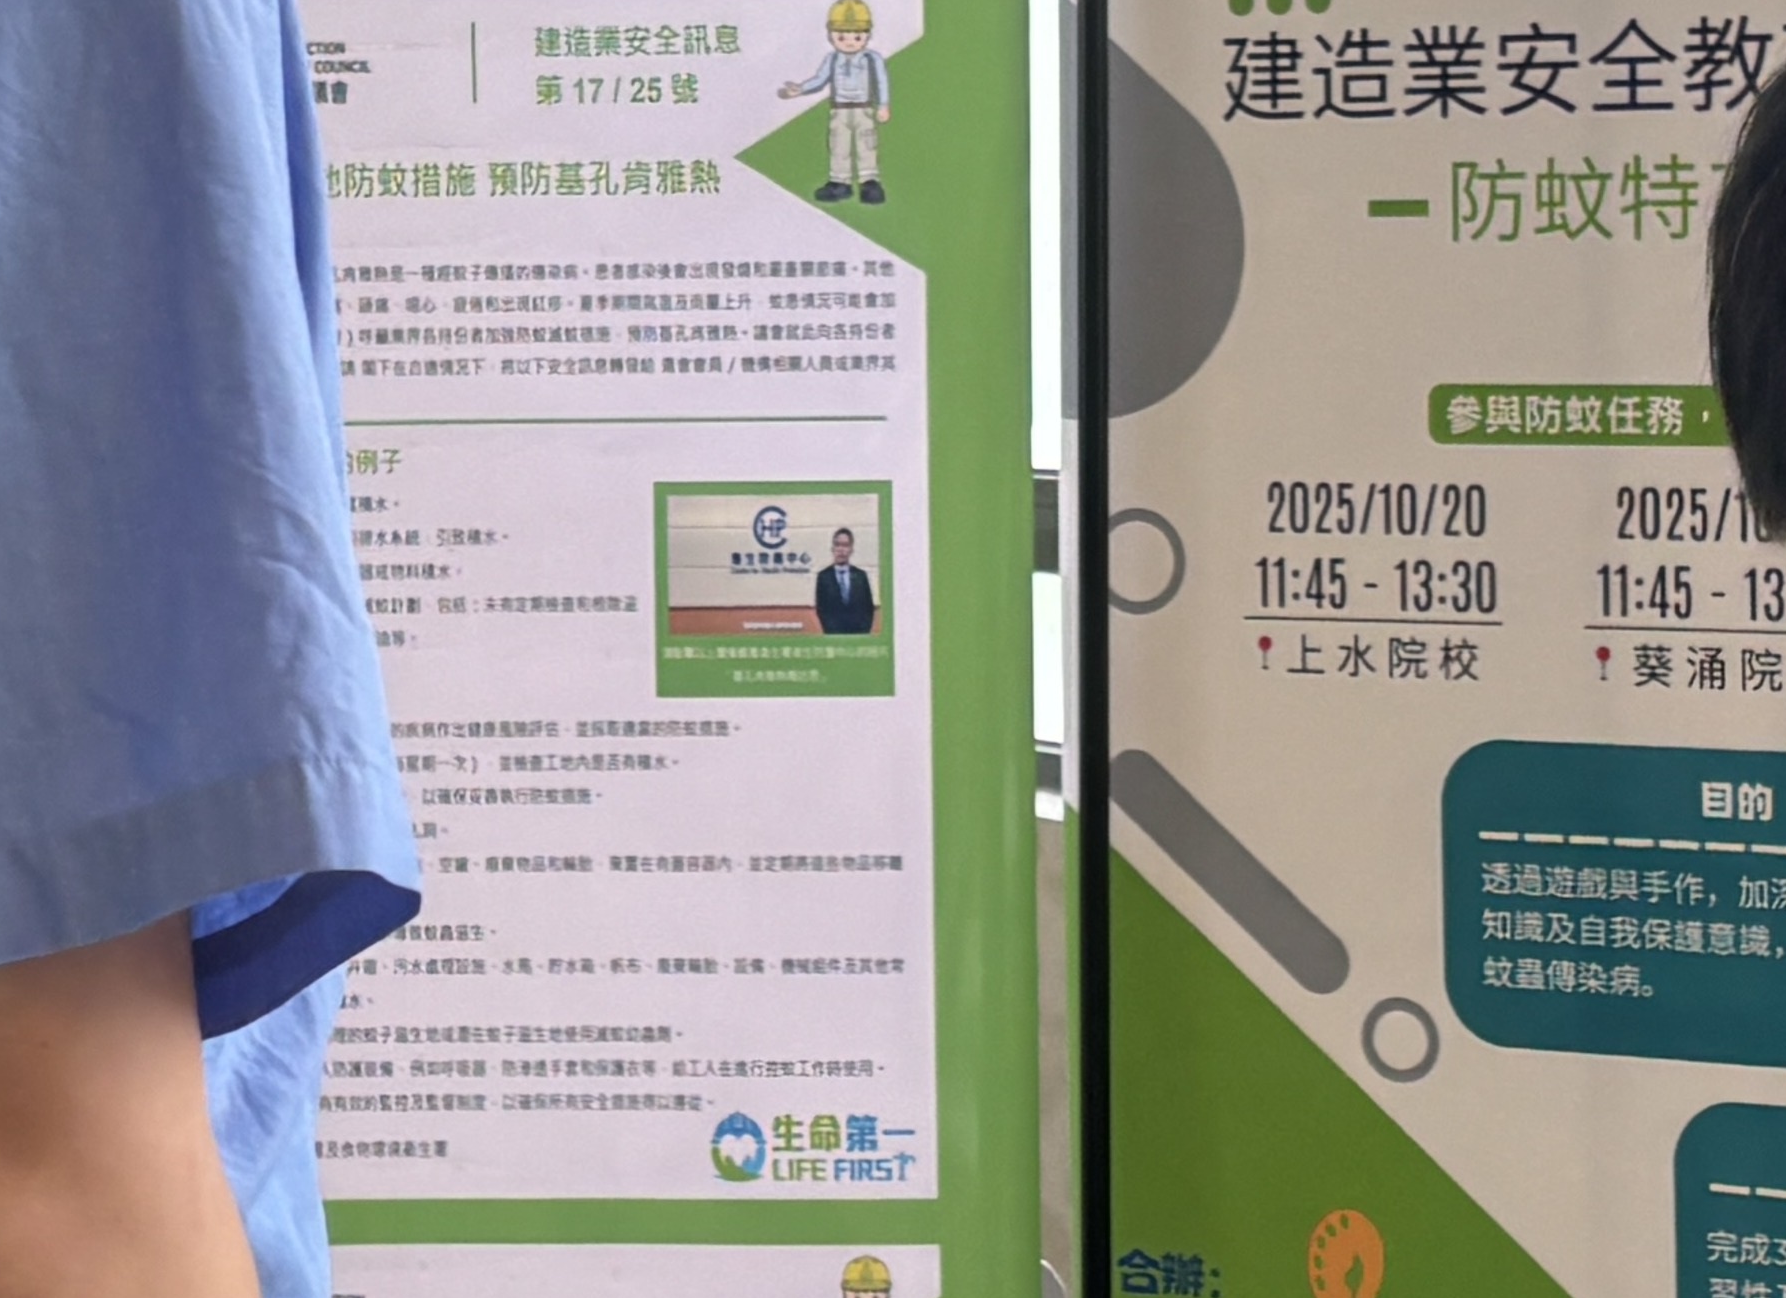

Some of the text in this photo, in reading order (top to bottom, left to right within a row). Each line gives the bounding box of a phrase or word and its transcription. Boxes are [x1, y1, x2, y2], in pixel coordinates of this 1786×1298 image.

[534, 25, 742, 58] 建造業安全訊息
[536, 74, 564, 105] 第
[573, 78, 604, 103] 17
[630, 76, 662, 102] 25
[670, 73, 700, 104] 號
[489, 159, 722, 197] 預防基孔肯雅熱
[1266, 481, 1488, 538] 2025/10/20
[1254, 558, 1348, 610] 11:45
[1393, 561, 1497, 615] 13:30
[1597, 564, 1692, 619] 11:45
[1285, 636, 1482, 683] 上水院校
[1701, 781, 1774, 822] 目的
[1482, 956, 1655, 999] 蚊蟲傳染病。
[772, 1113, 914, 1153] 生命第一
[773, 1151, 915, 1182] LIFE FIRST
